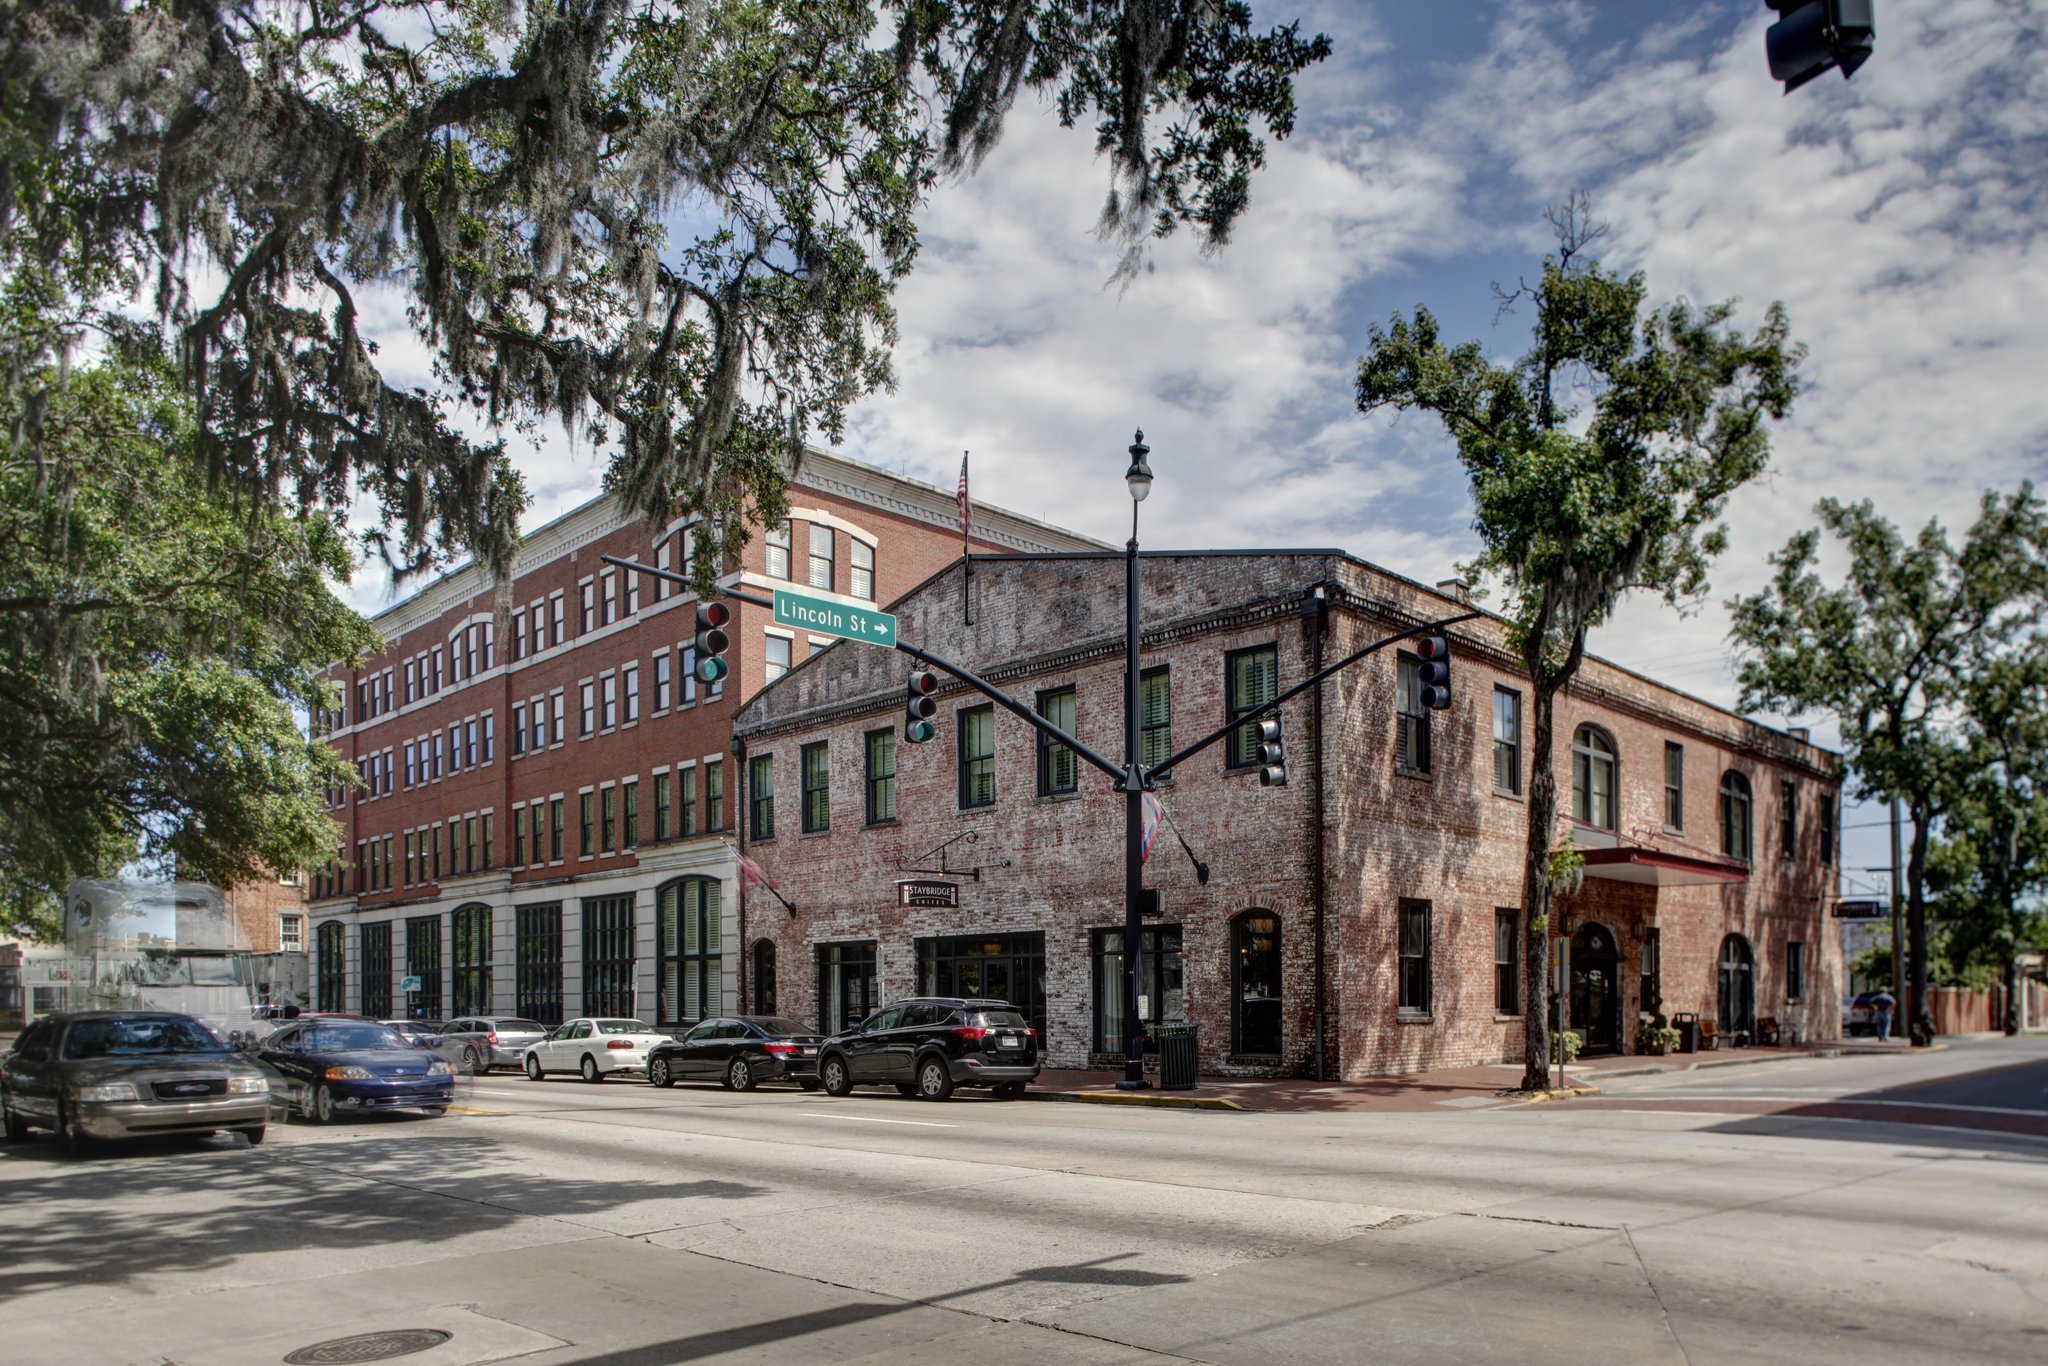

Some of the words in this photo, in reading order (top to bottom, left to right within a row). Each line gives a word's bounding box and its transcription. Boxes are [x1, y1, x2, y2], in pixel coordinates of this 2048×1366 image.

[781, 599, 842, 629] Lincoln
[850, 614, 866, 634] St
[909, 886, 951, 896] STAYBRIDGE
